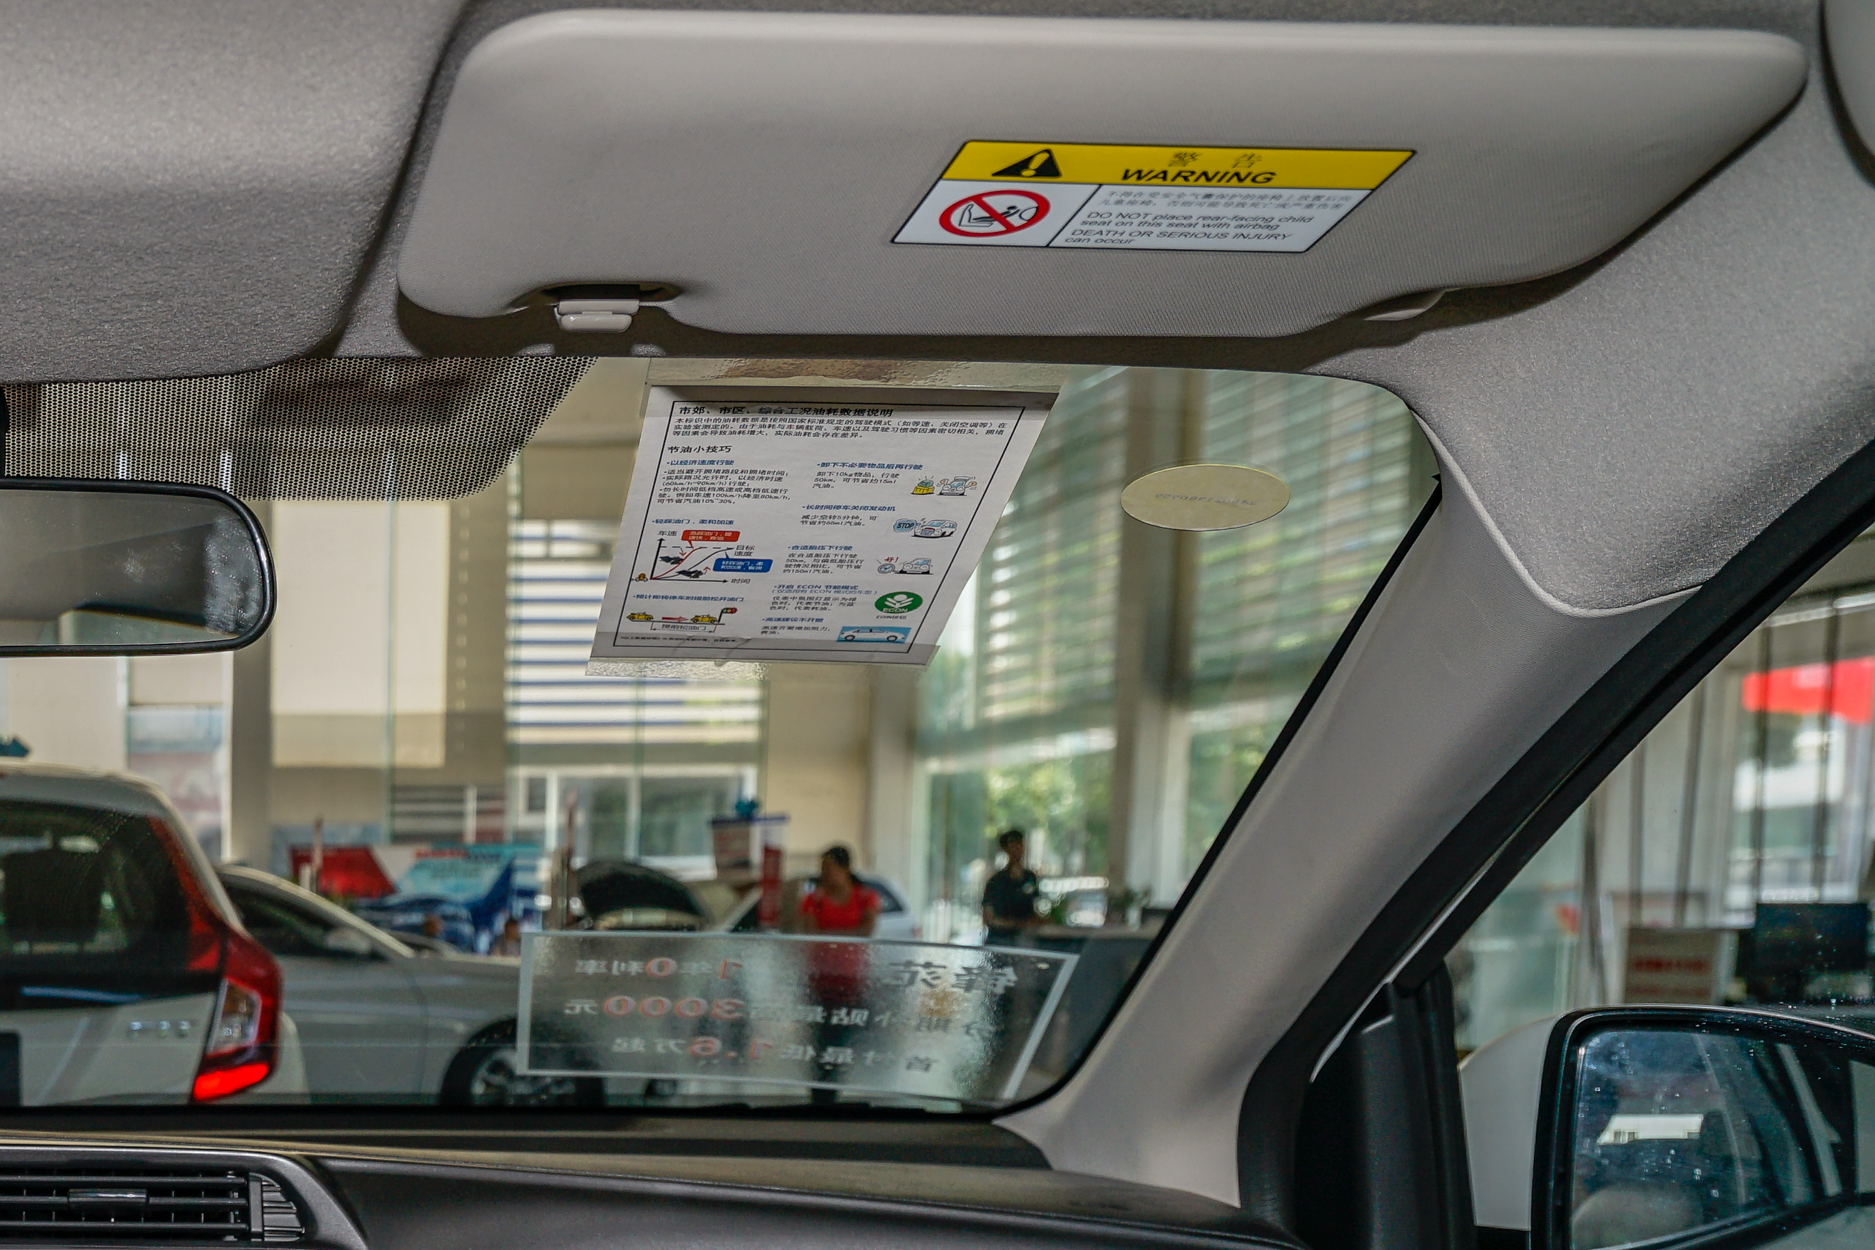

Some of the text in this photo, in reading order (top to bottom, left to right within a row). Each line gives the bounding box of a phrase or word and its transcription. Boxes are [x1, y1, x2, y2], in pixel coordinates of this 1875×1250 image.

[1122, 168, 1277, 184] WARNING
[1087, 211, 1112, 219] DO
[1115, 212, 1153, 220] NOT
[1137, 220, 1163, 228] this
[1234, 223, 1280, 231] airbag
[1071, 229, 1293, 240] DEATH OR SERIOUS INJURY
[667, 445, 733, 454] 节油小技巧
